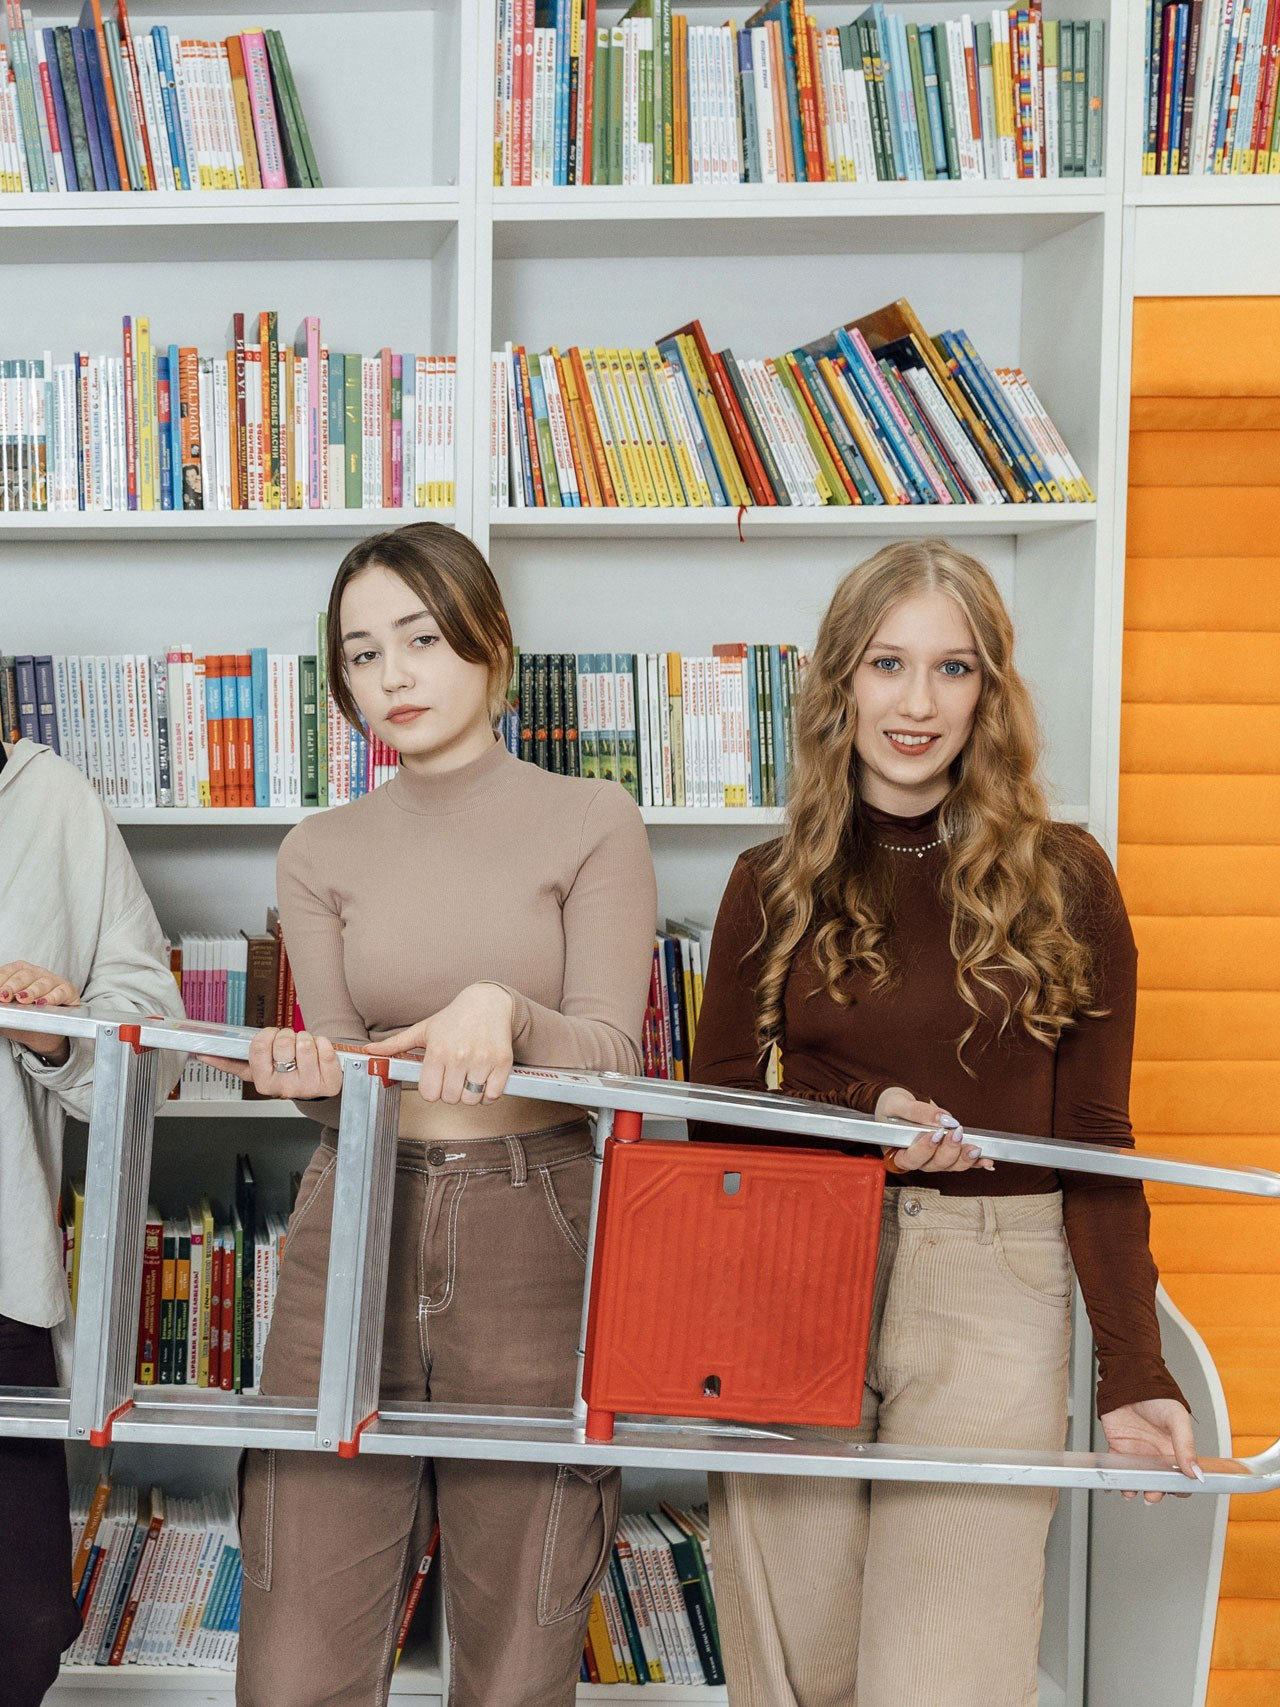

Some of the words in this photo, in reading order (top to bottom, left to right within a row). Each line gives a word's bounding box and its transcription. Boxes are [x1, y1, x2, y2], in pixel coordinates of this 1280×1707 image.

[236, 338, 245, 399] БАСНИ
[126, 662, 134, 704] ХОТТАБЫЧ
[140, 662, 148, 705] ХОТТАБЫЧ
[308, 766, 315, 778] ЯН
